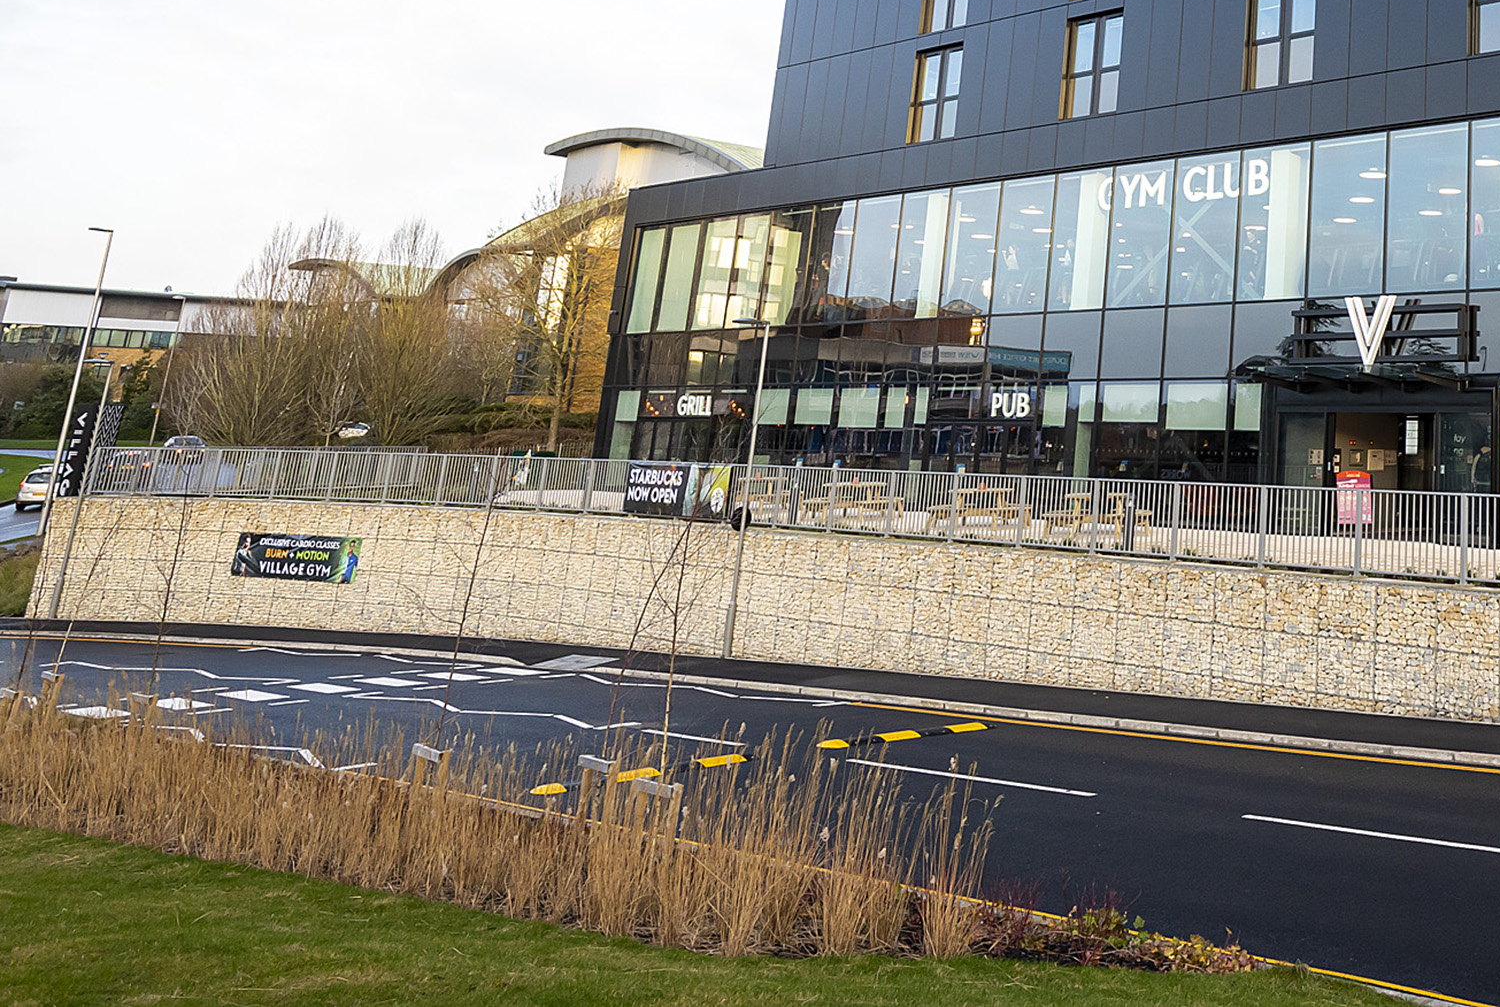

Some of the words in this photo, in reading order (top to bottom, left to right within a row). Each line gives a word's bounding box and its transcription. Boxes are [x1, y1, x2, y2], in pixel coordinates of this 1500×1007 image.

[1183, 159, 1270, 202] CLUB
[677, 395, 712, 416] GRILL
[990, 393, 1030, 418] PUB
[629, 469, 683, 486] STARBUCKS
[627, 486, 651, 502] NOW
[650, 487, 678, 504] OPEN
[259, 538, 291, 548] EXCLUSIVE
[291, 539, 315, 548] CARDIO
[316, 540, 341, 549] CLASSES
[265, 548, 288, 559] BURN
[295, 551, 330, 561] MOTION
[259, 560, 305, 576] VILLAGE
[306, 564, 332, 577] GYM
